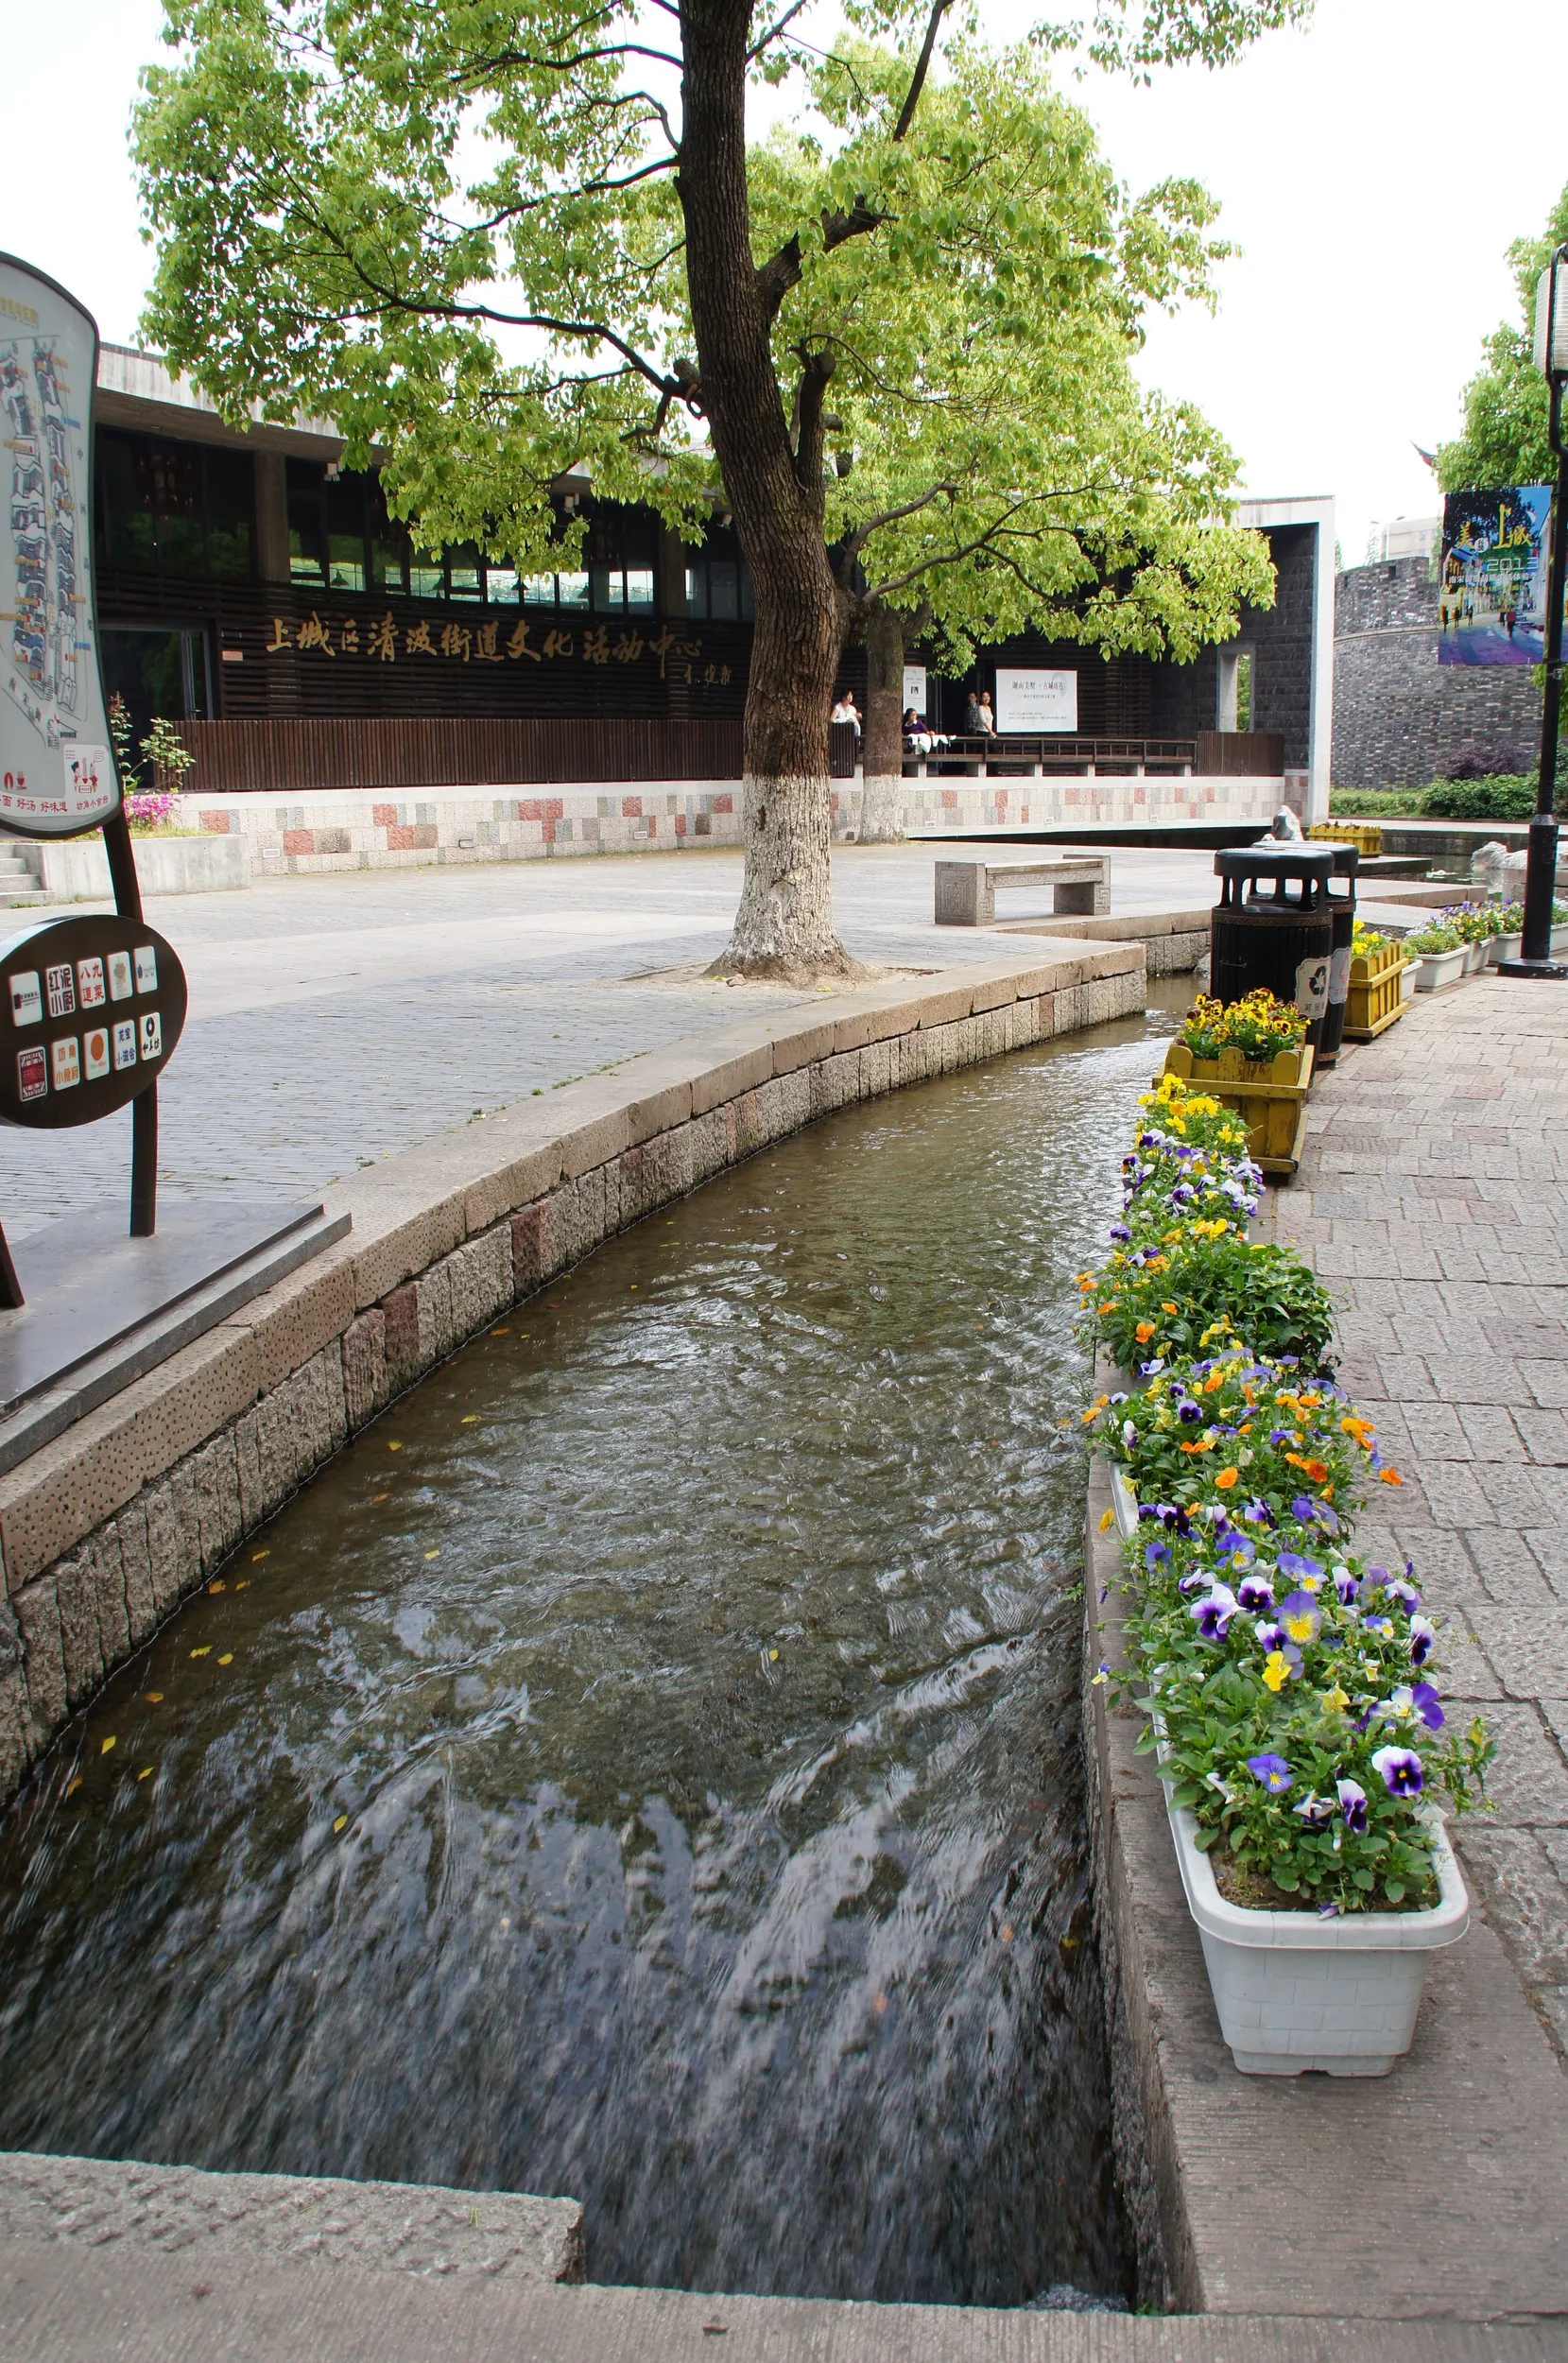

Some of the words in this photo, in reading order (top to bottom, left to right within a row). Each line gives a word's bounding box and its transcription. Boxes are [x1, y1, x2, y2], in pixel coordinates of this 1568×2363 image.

[1487, 556, 1539, 572] 2013
[266, 611, 704, 679] 上城区清波街道文化活动中心
[16, 797, 37, 812] 好汤
[40, 800, 69, 814] 好味道
[49, 967, 73, 992] 红泥
[80, 962, 103, 980] 八九
[51, 990, 75, 1015] 小厨
[82, 984, 105, 1003] 道菜
